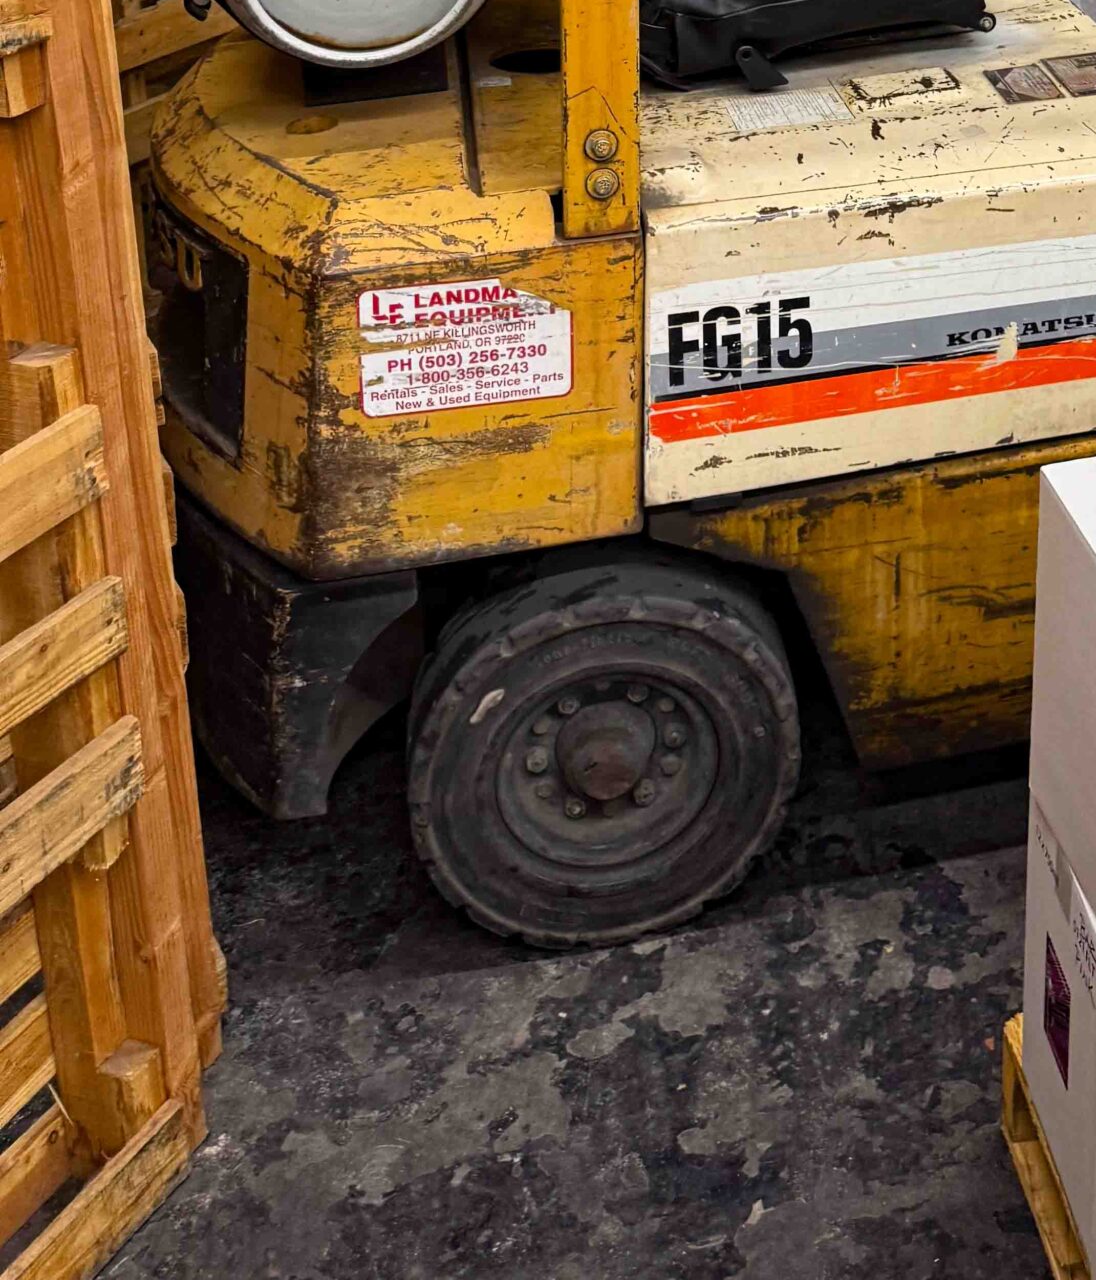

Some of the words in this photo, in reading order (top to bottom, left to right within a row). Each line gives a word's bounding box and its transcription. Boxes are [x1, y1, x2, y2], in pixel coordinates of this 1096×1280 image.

[414, 285, 518, 308] LANDMA
[414, 302, 557, 328] EQUIPME
[443, 319, 536, 339] KILLINGSWORTH
[667, 296, 813, 387] FG15
[475, 337, 492, 348] OR
[387, 359, 412, 373] PH
[419, 353, 464, 372] (503)
[468, 344, 548, 365] 256-7330
[406, 361, 529, 386] 1-800-356-6243
[370, 388, 418, 402] Rentals
[429, 383, 464, 396] Sales
[475, 377, 521, 391] Service
[532, 372, 564, 384] Parts
[395, 399, 422, 412] New
[426, 397, 435, 408] &
[439, 394, 471, 406] Used
[475, 386, 541, 402] Equipment
